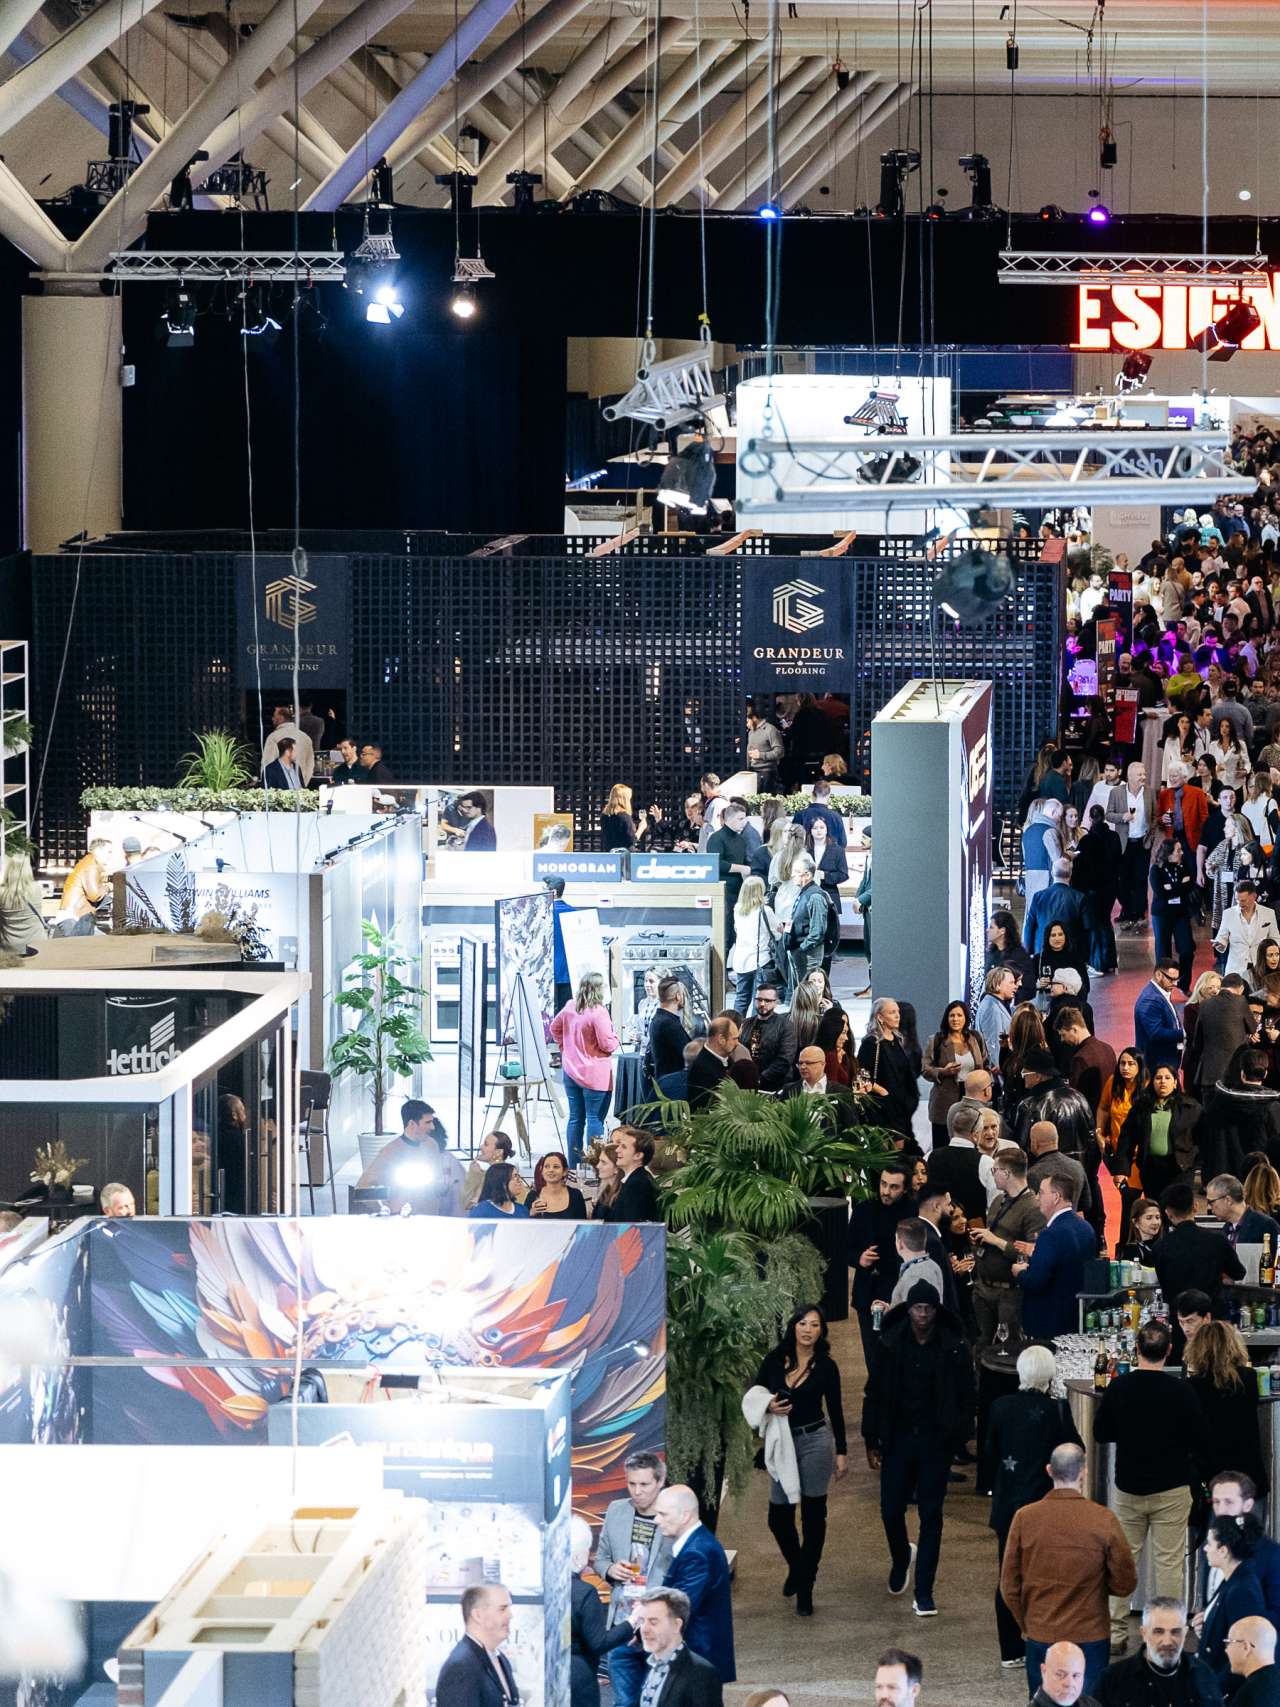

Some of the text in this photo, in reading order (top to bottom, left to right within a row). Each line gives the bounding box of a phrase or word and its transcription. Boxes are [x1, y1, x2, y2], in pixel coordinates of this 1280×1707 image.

[1110, 588, 1132, 602] PARTY
[753, 647, 845, 659] GRANDEUR
[775, 667, 826, 675] FLOORING
[537, 863, 616, 873] MONOGRAM
